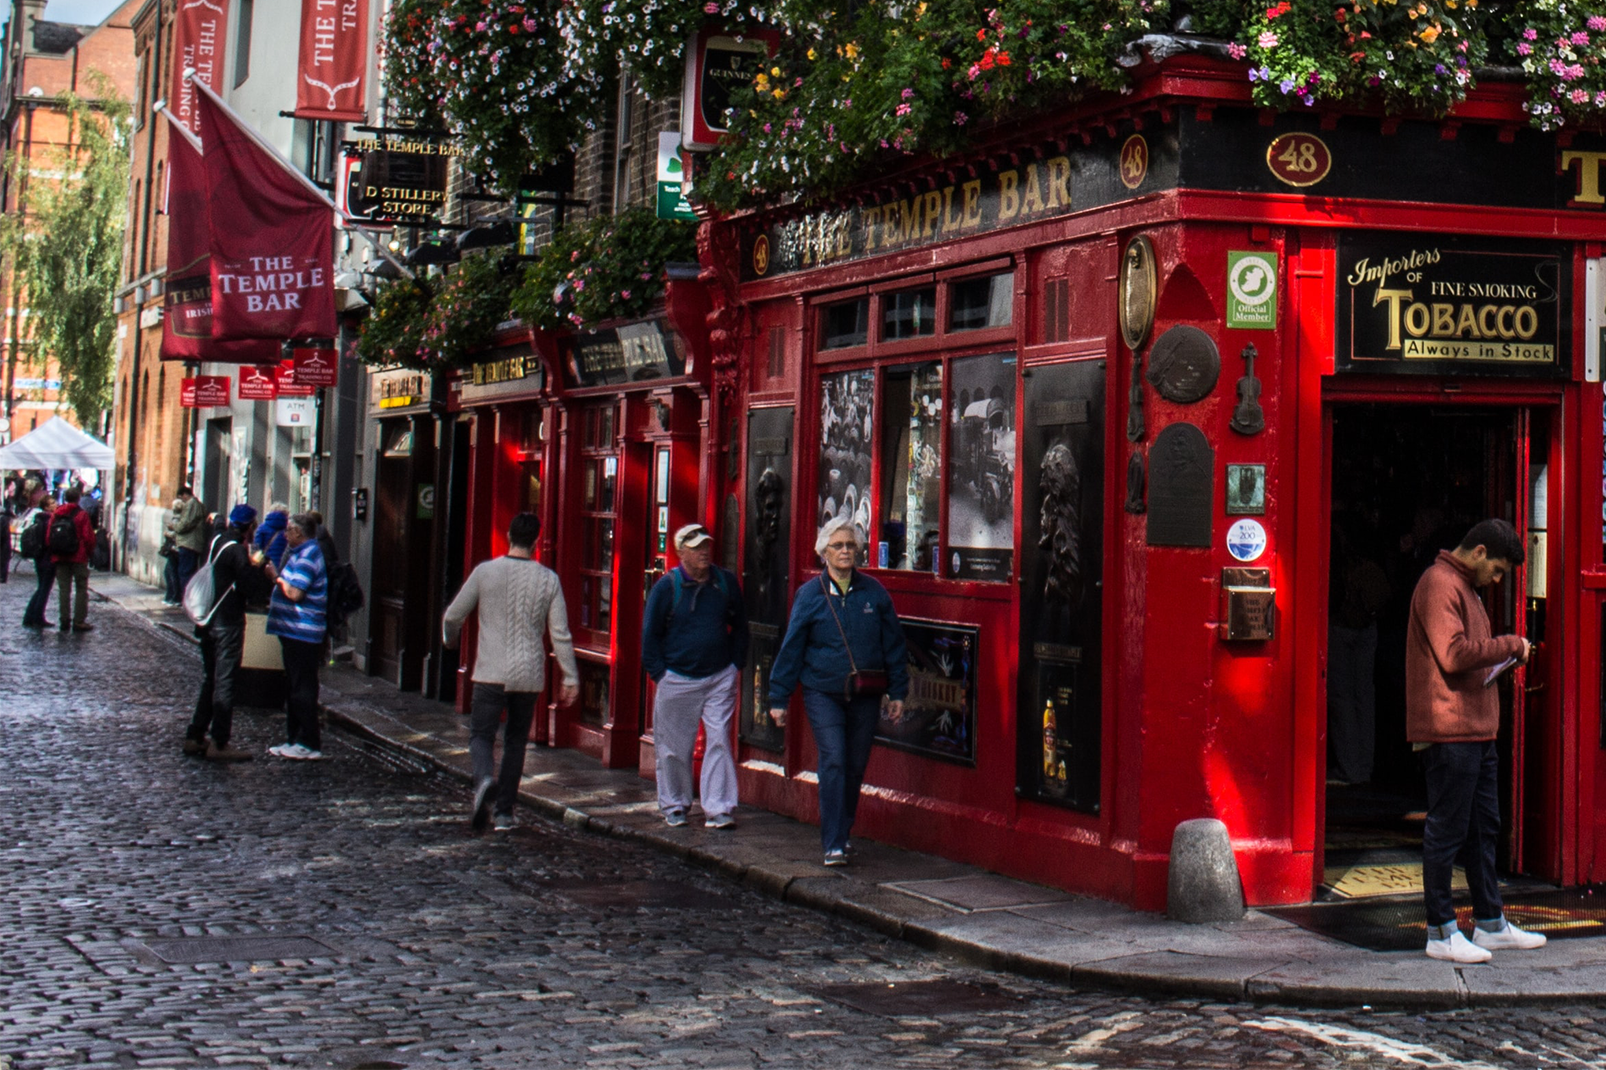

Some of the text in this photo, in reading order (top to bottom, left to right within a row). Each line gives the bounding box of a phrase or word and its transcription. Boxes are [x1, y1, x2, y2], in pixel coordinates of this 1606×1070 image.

[199, 19, 216, 56] THE
[314, 16, 336, 67] THE
[179, 44, 195, 116] TRDING
[709, 68, 751, 78] GUINNES
[357, 138, 382, 151] THE
[385, 140, 437, 155] TEMPLE
[1278, 139, 1319, 173] 48
[1123, 144, 1144, 179] 48
[383, 201, 432, 215] STORE
[862, 179, 982, 250] TEMPLE
[1000, 155, 1072, 220] BAR
[250, 256, 295, 272] THE
[1347, 247, 1441, 288] Importers
[218, 268, 325, 294] TEMPLE
[1406, 272, 1423, 283] OF
[170, 286, 212, 305] TEMP
[1431, 281, 1538, 300] FINE SMOKING
[246, 293, 301, 313] BAR
[1238, 304, 1267, 313] Official
[1236, 312, 1269, 321] Member
[1372, 288, 1539, 351] TOBACCO
[1407, 341, 1552, 359] Always in Stock
[1239, 531, 1256, 540] 200
